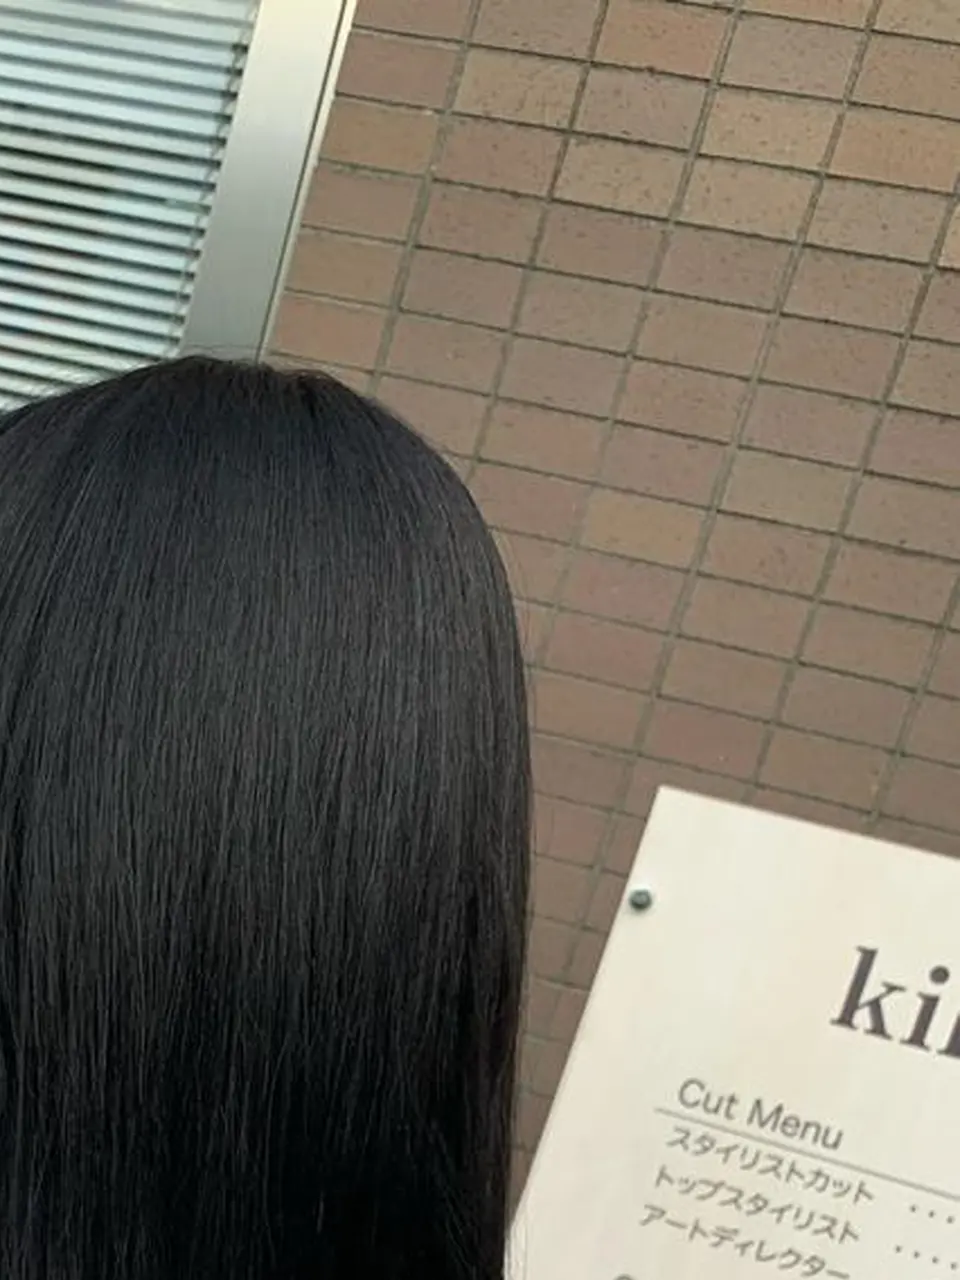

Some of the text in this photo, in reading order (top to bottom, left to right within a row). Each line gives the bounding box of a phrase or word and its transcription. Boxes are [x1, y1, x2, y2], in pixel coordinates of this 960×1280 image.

[678, 1078, 844, 1150] Cut Menu
[667, 1125, 875, 1204] スタイリストカット
[639, 1203, 851, 1280] アートディレクター
[654, 1166, 861, 1244] トップスタイリスト
